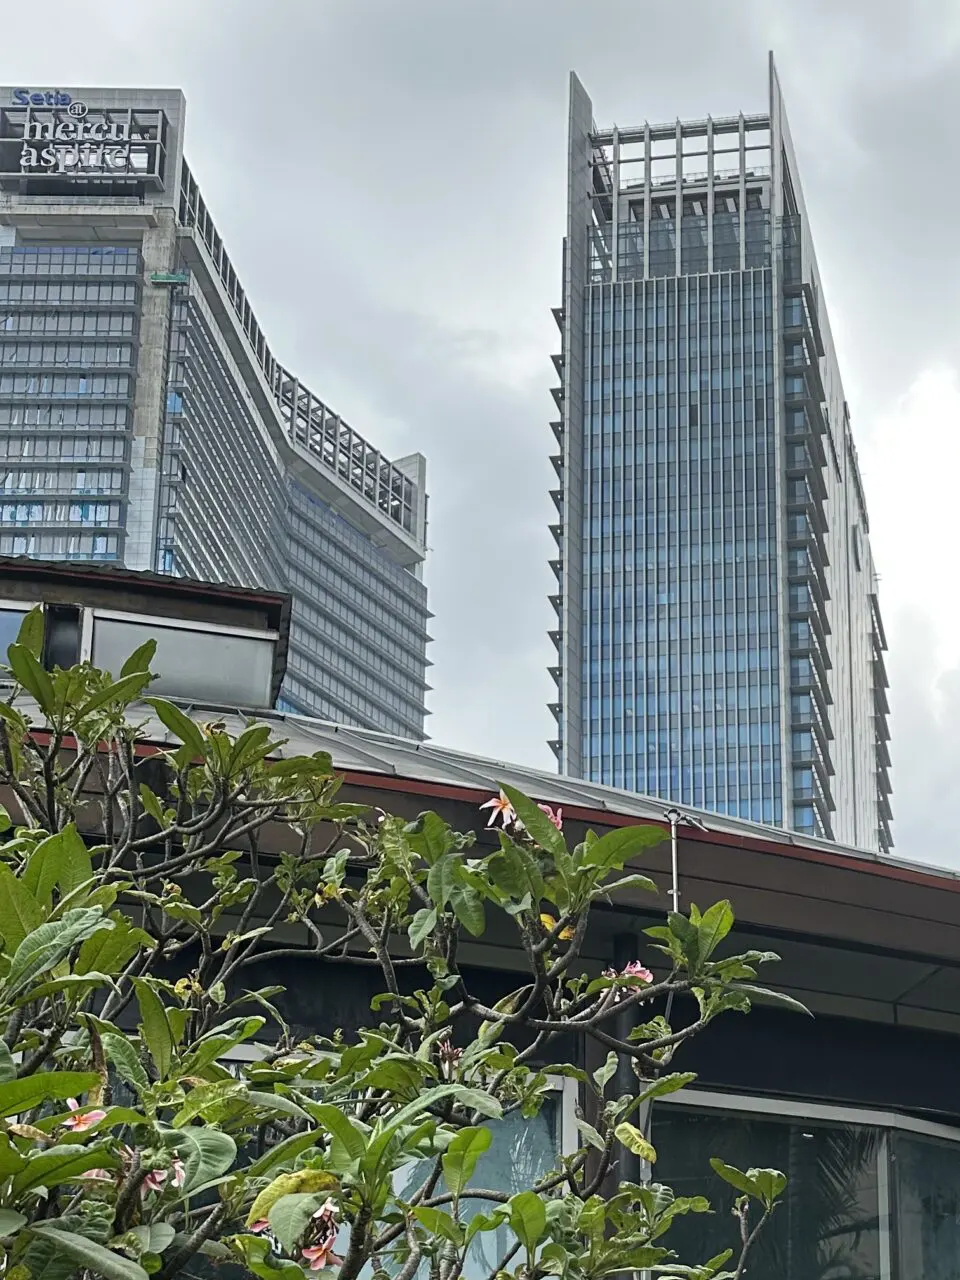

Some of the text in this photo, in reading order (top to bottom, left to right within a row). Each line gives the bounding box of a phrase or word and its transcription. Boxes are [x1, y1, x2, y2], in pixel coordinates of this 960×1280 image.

[12, 87, 72, 106] Setia
[20, 121, 131, 141] mercu
[20, 143, 129, 173] aspire
